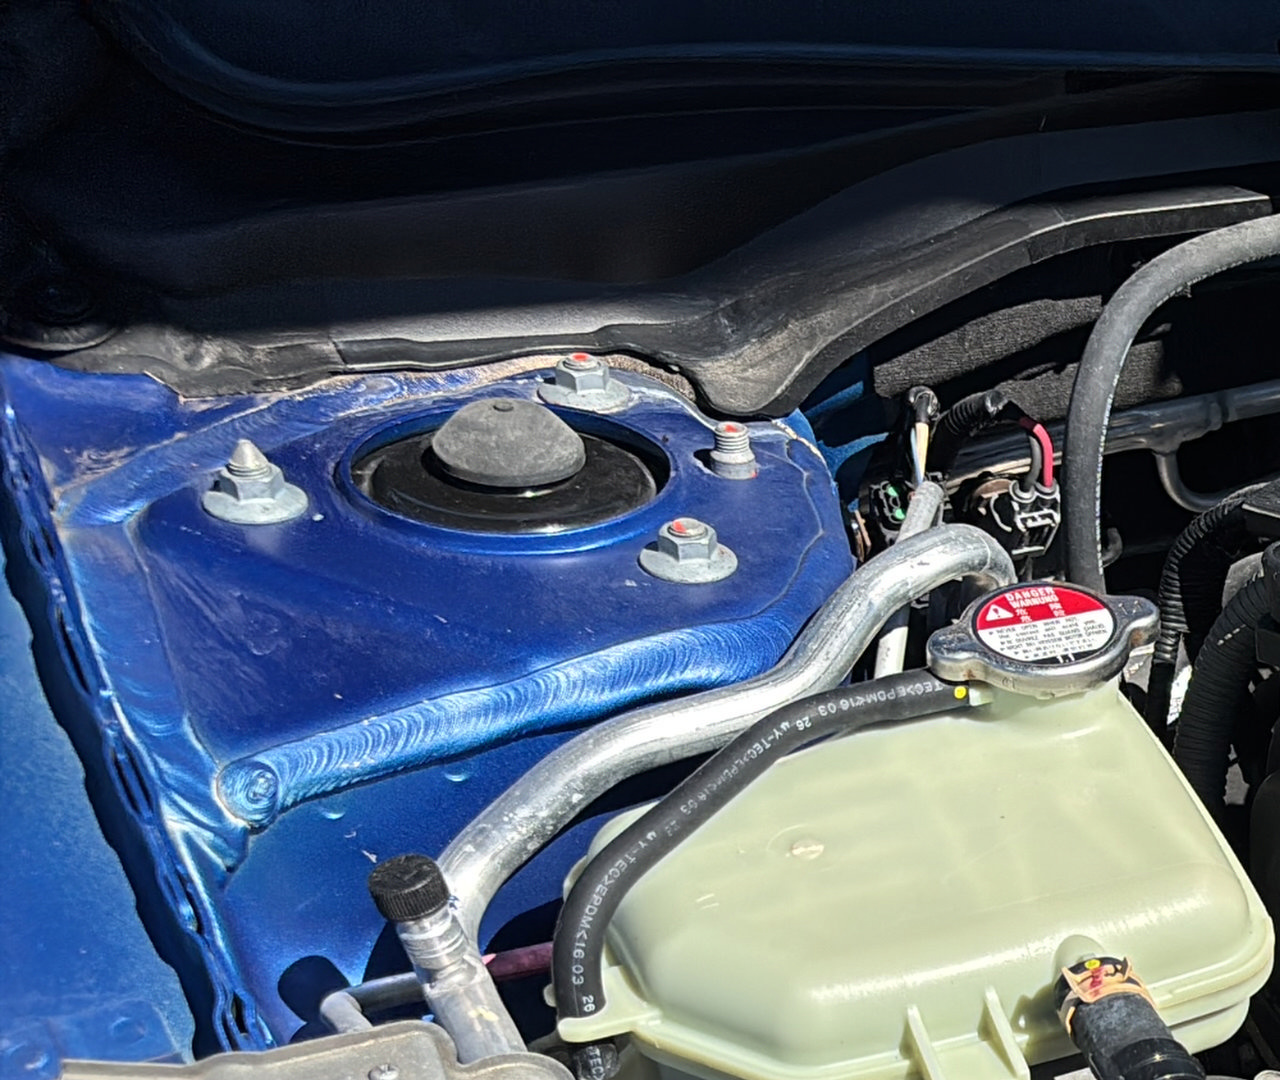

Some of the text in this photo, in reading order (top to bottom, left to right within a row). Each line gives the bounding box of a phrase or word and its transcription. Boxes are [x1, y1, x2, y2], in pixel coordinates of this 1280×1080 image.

[1005, 586, 1055, 601] DANGER
[1010, 594, 1060, 609] WARNUNG
[796, 716, 813, 731] 26
[571, 965, 584, 985] 03
[582, 995, 596, 1013] 26
